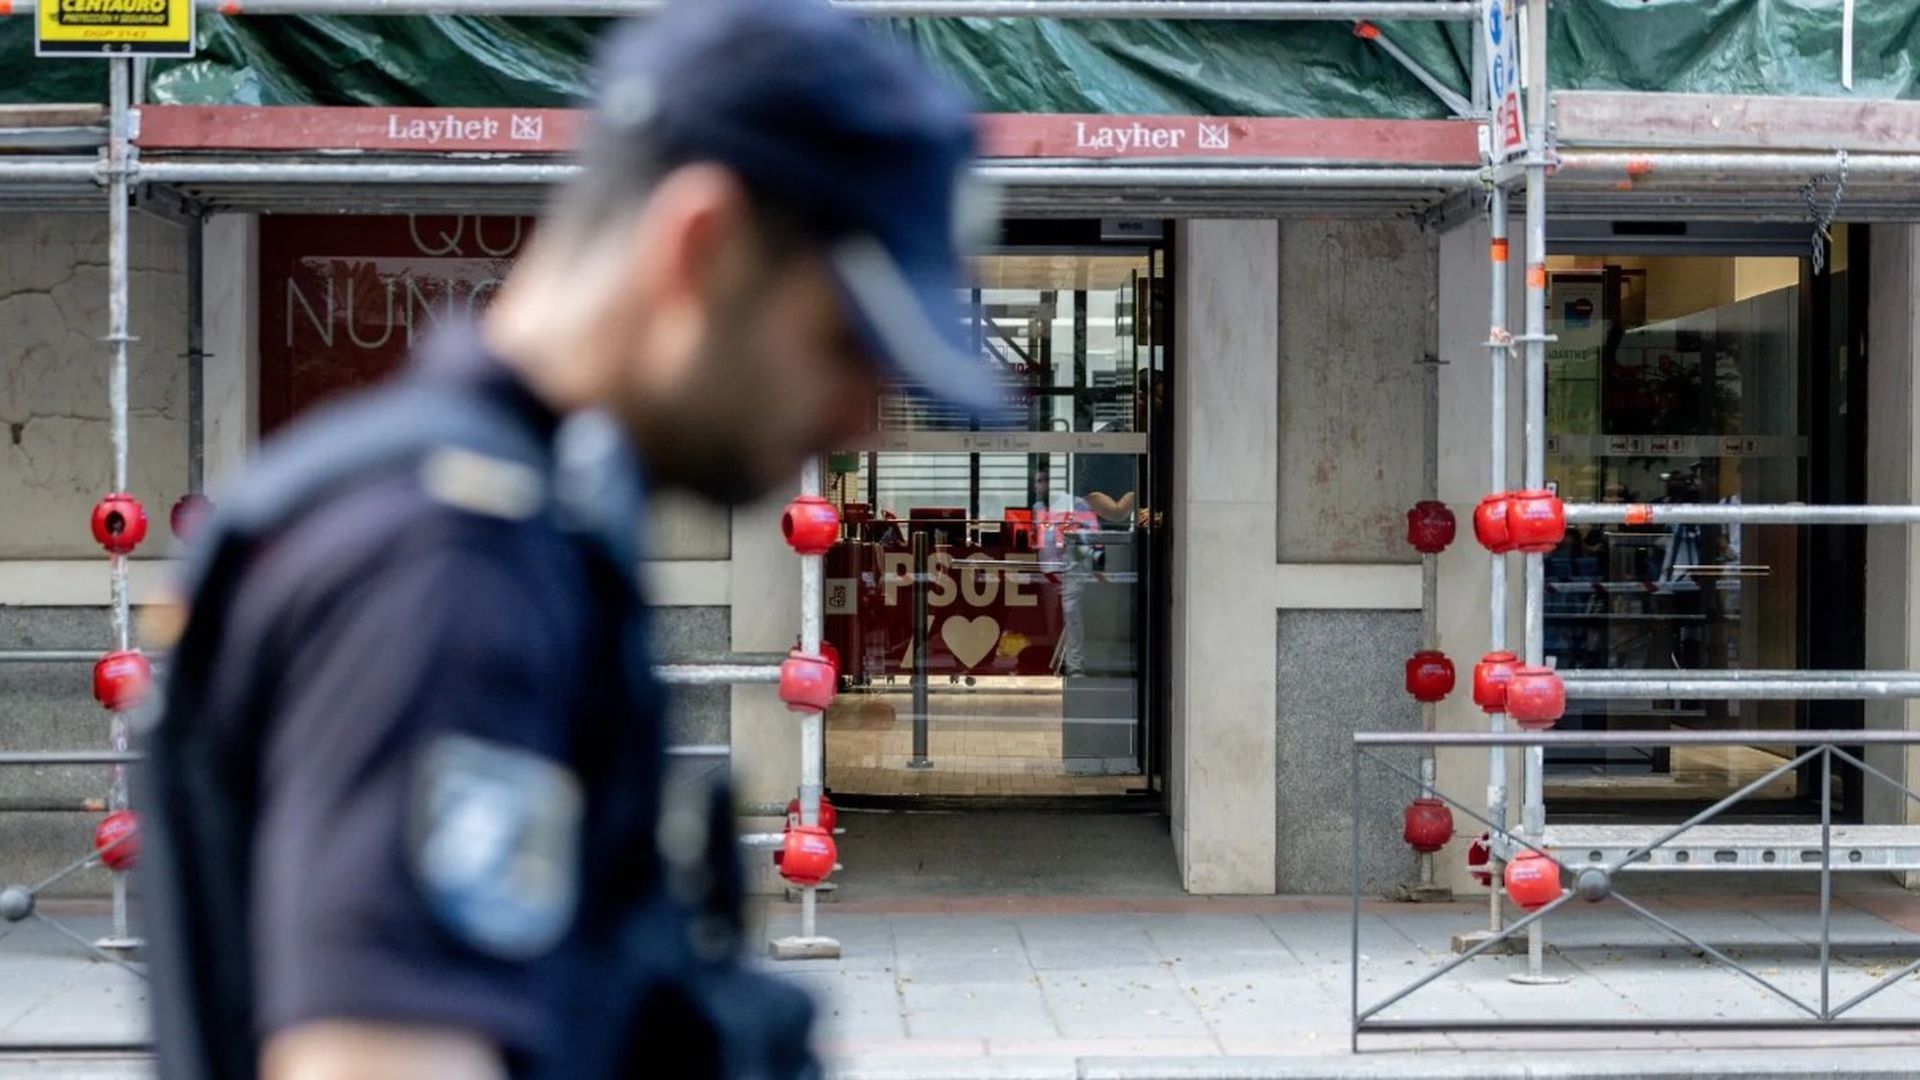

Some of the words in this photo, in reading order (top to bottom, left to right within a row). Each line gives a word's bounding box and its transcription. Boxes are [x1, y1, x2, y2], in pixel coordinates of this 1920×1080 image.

[61, 0, 167, 13] CENTAURO
[387, 114, 499, 145] Layher
[1074, 121, 1186, 153] Layher
[883, 552, 1039, 608] PSOE
